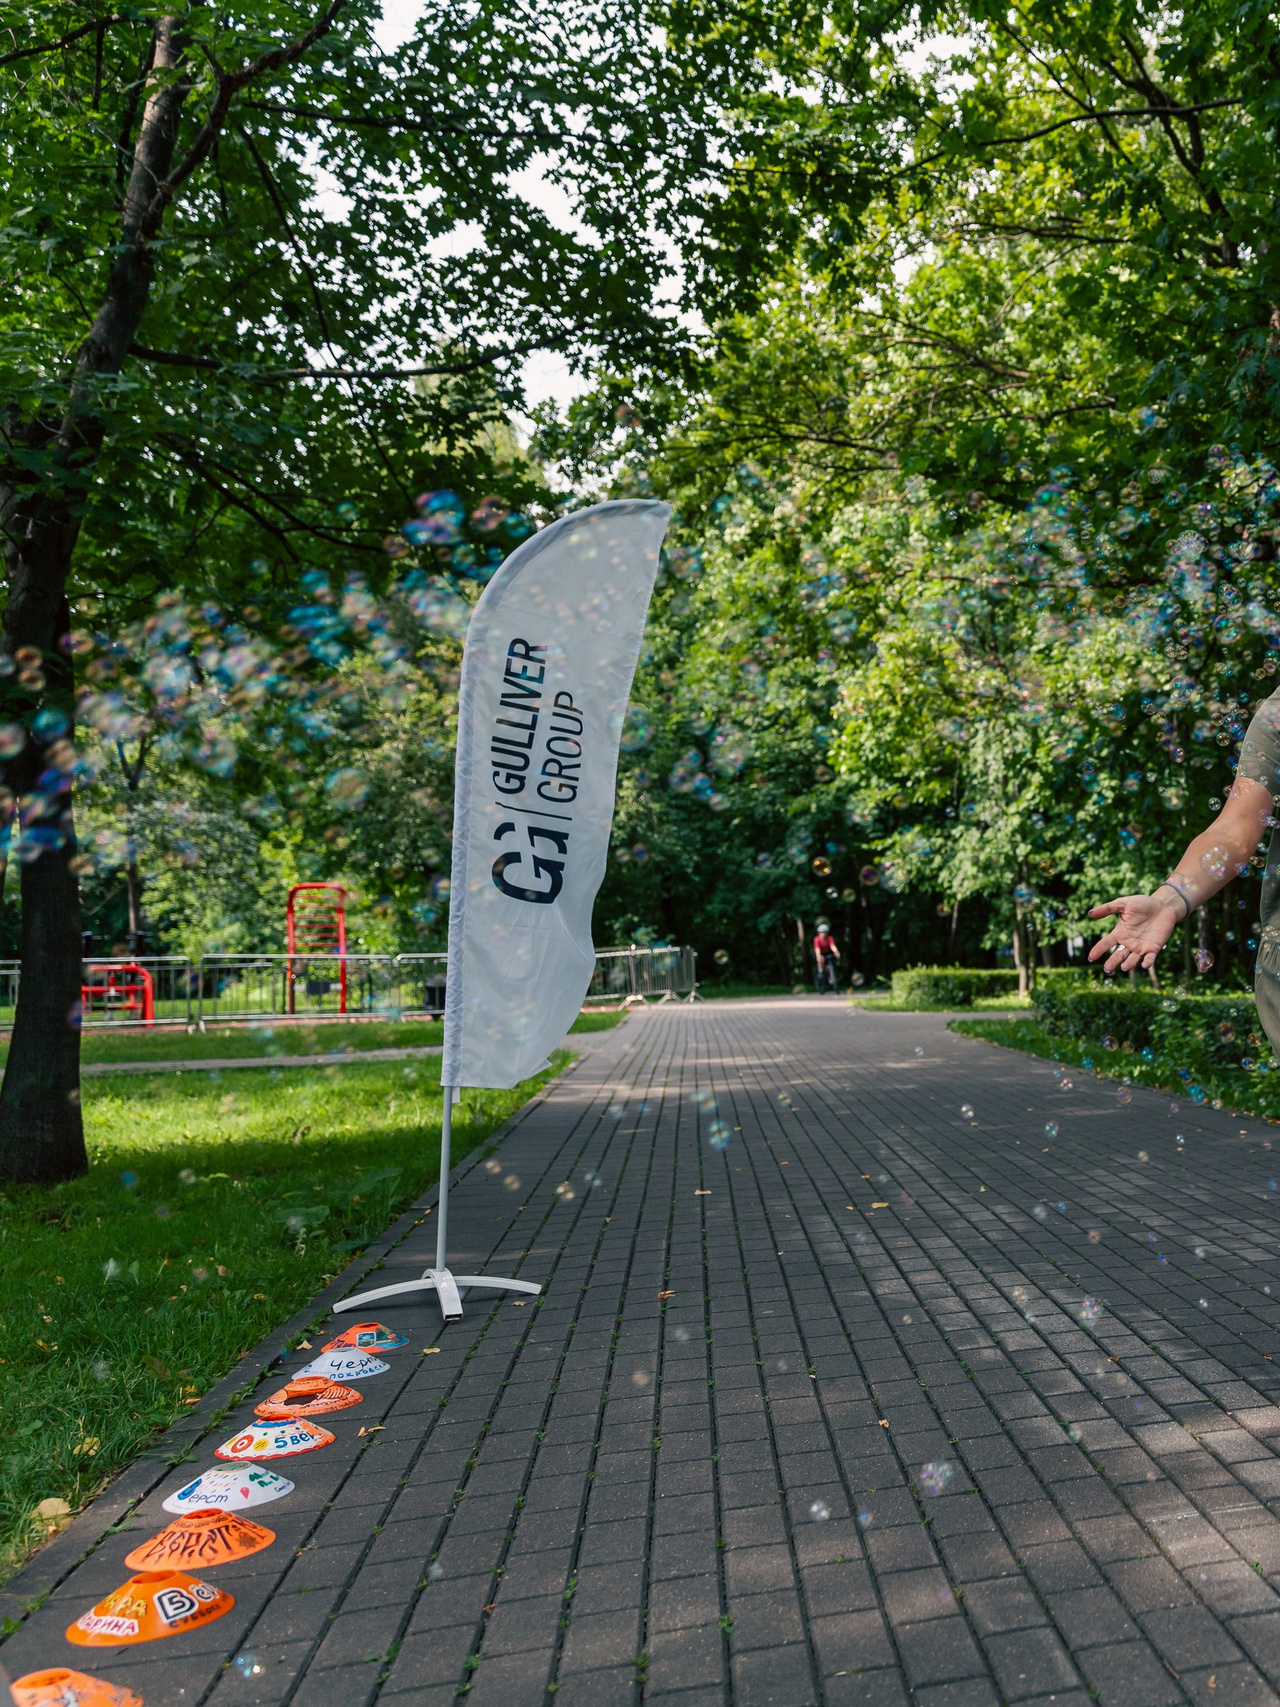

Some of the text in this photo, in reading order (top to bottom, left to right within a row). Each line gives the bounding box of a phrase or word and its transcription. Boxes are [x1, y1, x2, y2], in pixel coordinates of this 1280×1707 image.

[491, 637, 548, 795] GULLIVER
[536, 690, 584, 803] GROUP
[274, 1436, 288, 1449] 5
